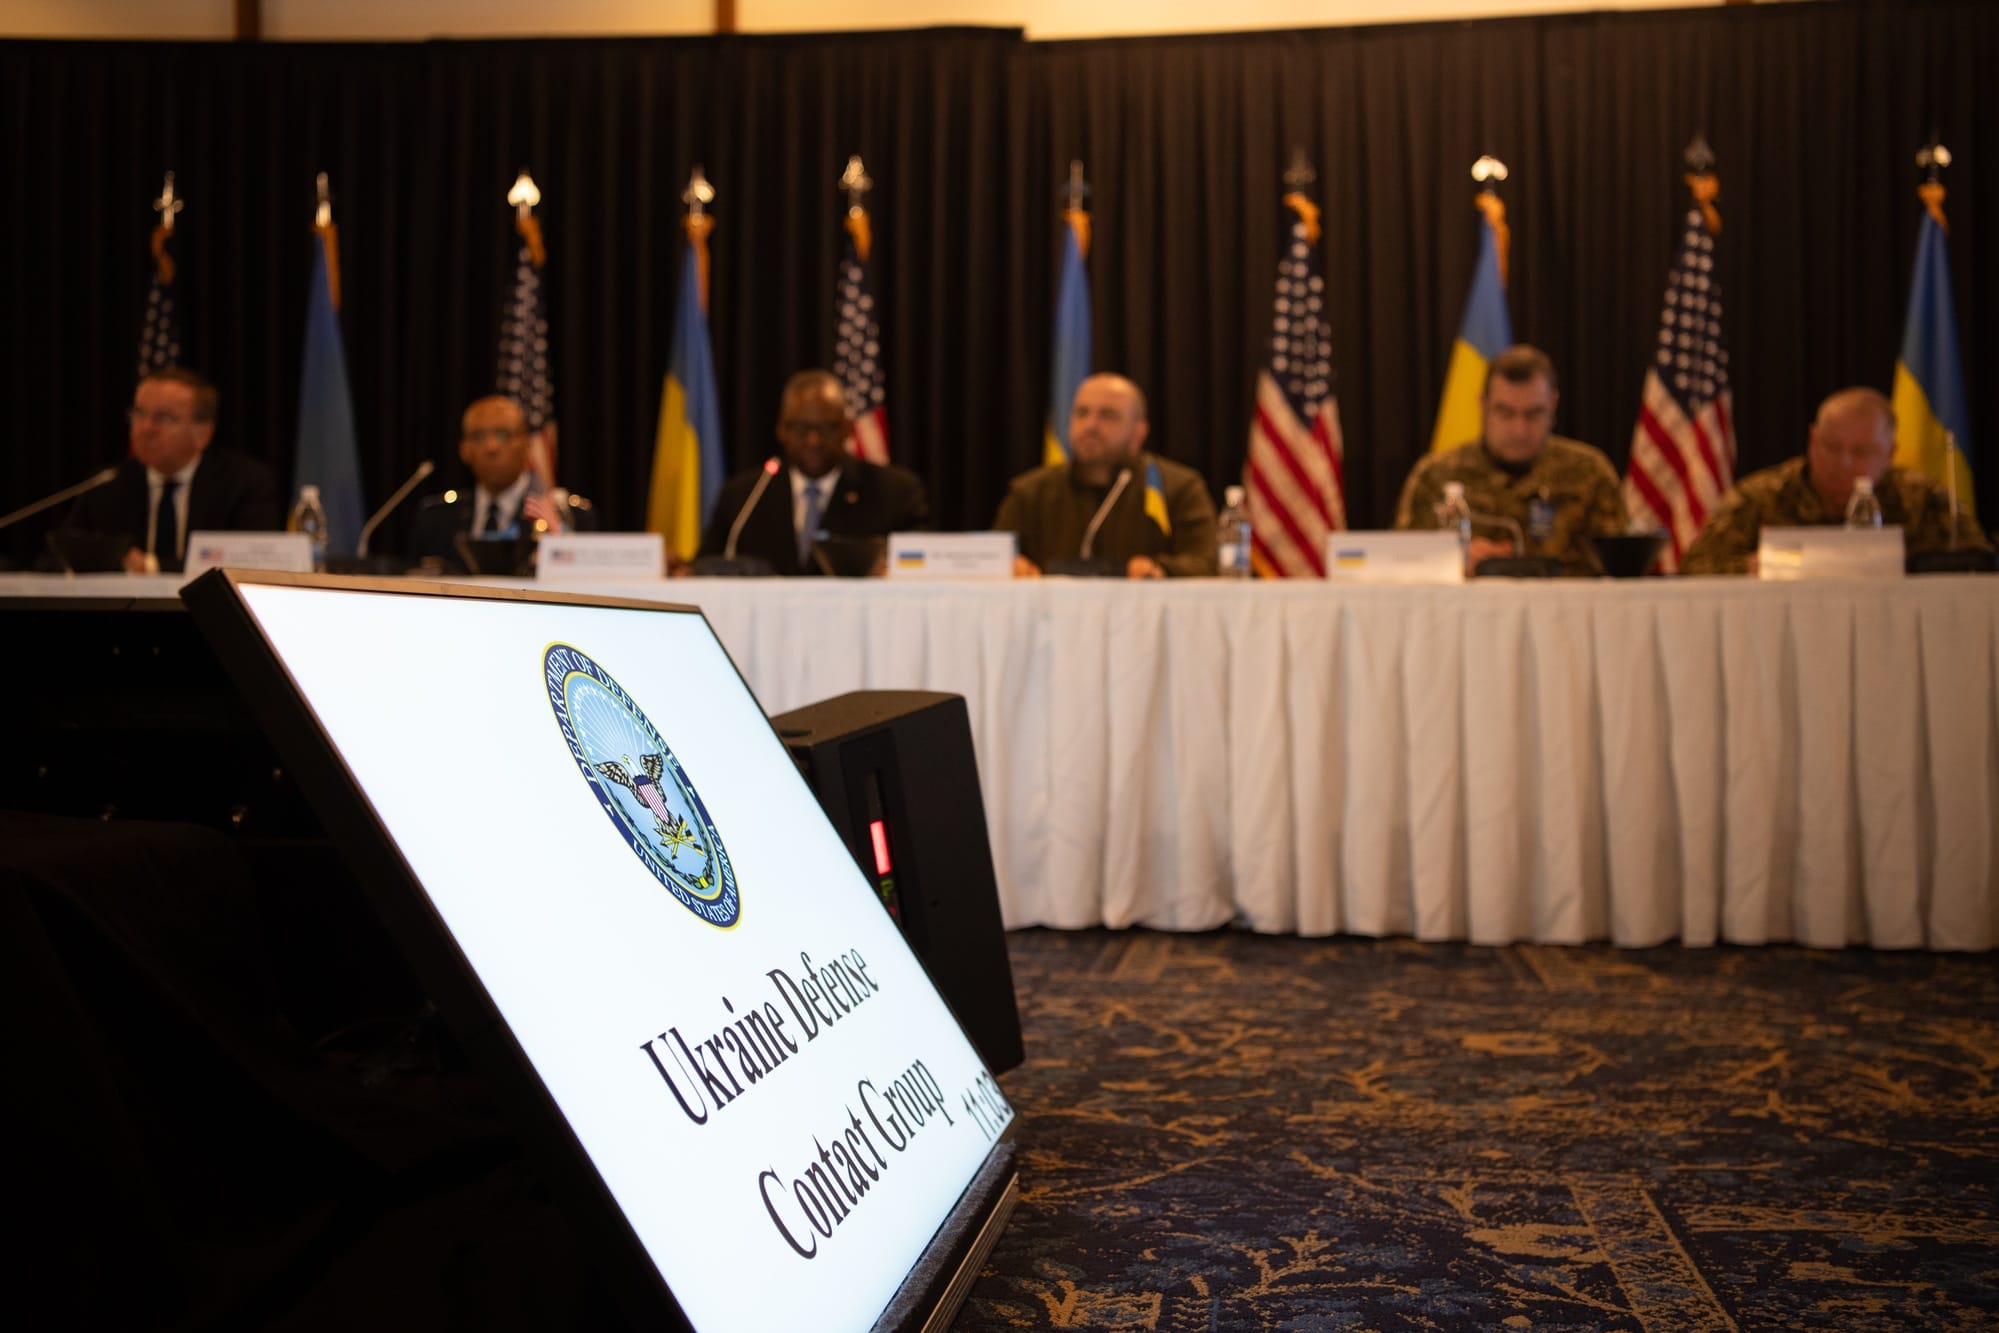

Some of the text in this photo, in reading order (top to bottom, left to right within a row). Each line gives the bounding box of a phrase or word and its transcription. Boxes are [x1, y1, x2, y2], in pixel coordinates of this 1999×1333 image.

[547, 648, 679, 781] DEPARTMENT OF DEFENSE
[633, 825, 737, 922] UNITED STATES OF AMERICA
[639, 948, 879, 1125] Ukraine Defense
[758, 1059, 954, 1259] Contact Group
